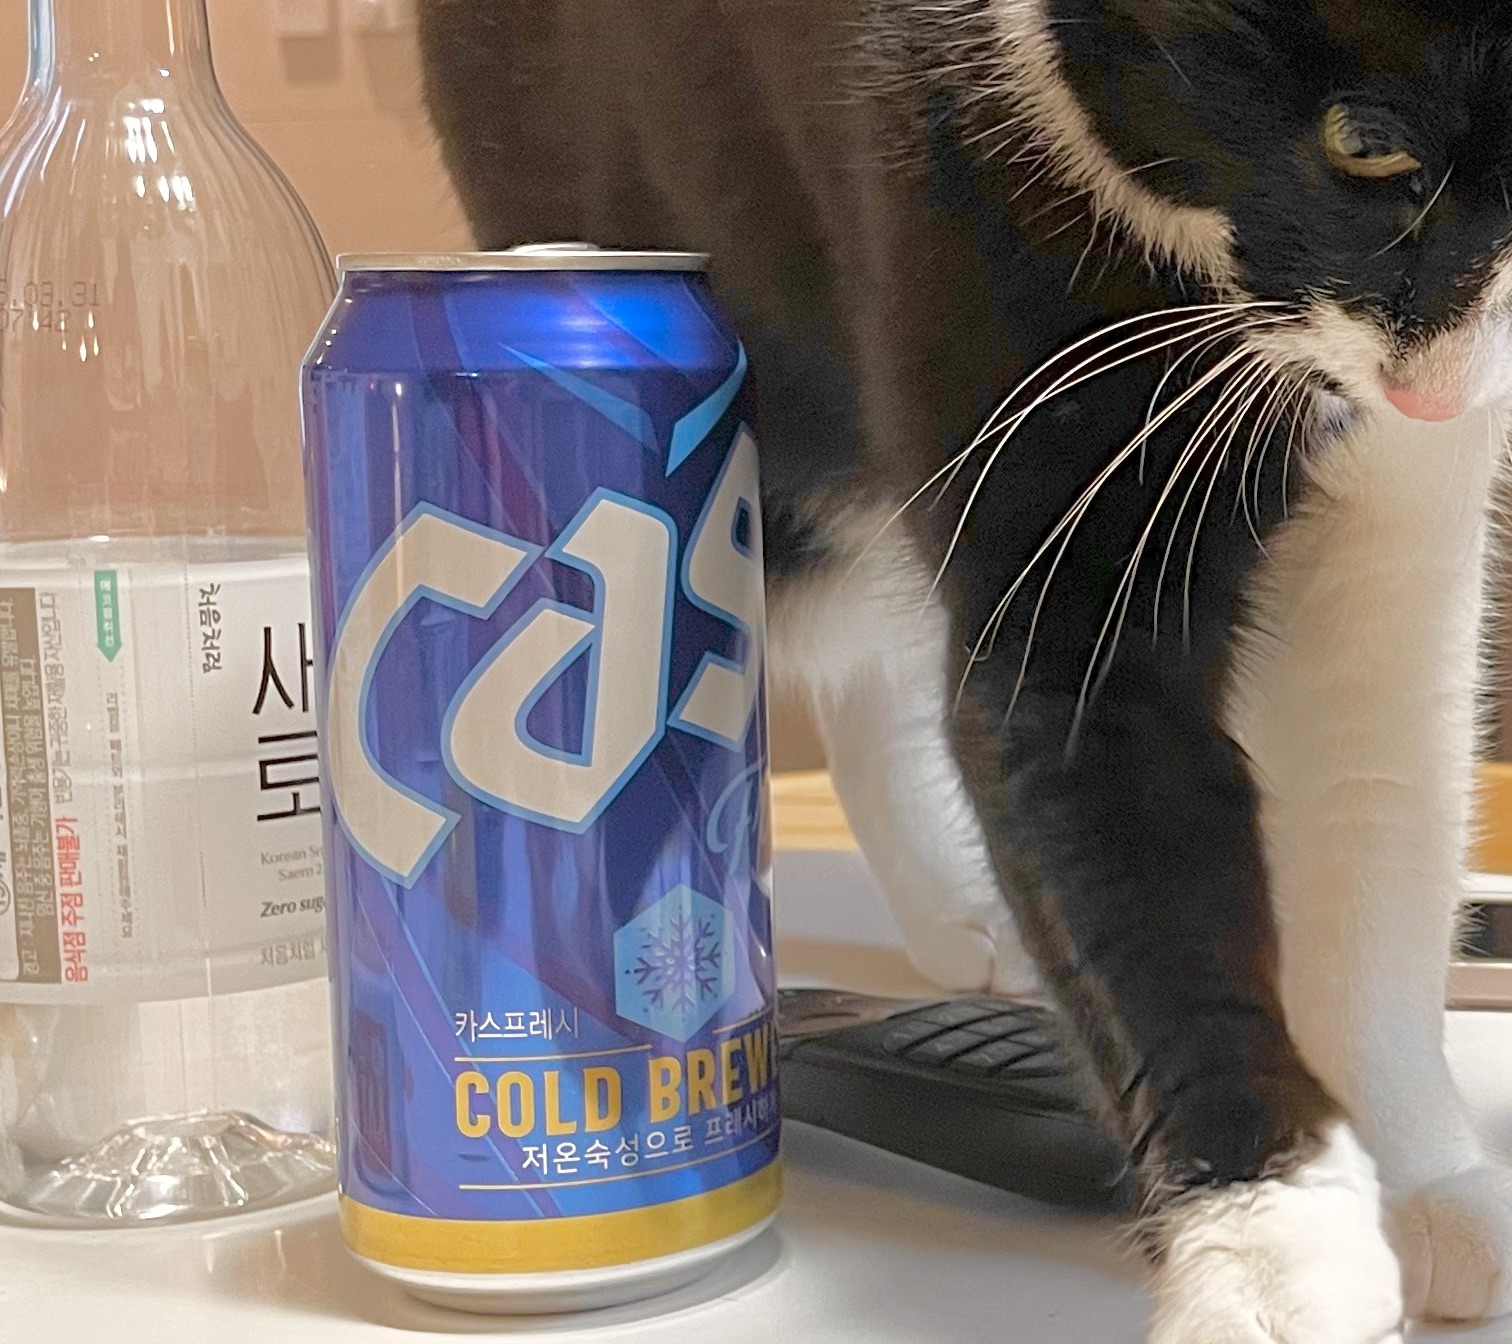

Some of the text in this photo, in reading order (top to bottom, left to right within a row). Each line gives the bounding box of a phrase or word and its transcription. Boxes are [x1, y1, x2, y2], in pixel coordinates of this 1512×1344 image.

[199, 582, 223, 674] 처음처럼
[54, 816, 88, 983] 음식점 주점 판매불가
[260, 895, 325, 919] Zero sug
[454, 1007, 580, 1043] 카스프레시
[454, 1019, 778, 1139] COLD BREW
[521, 1126, 694, 1176] 저온숙성으로
